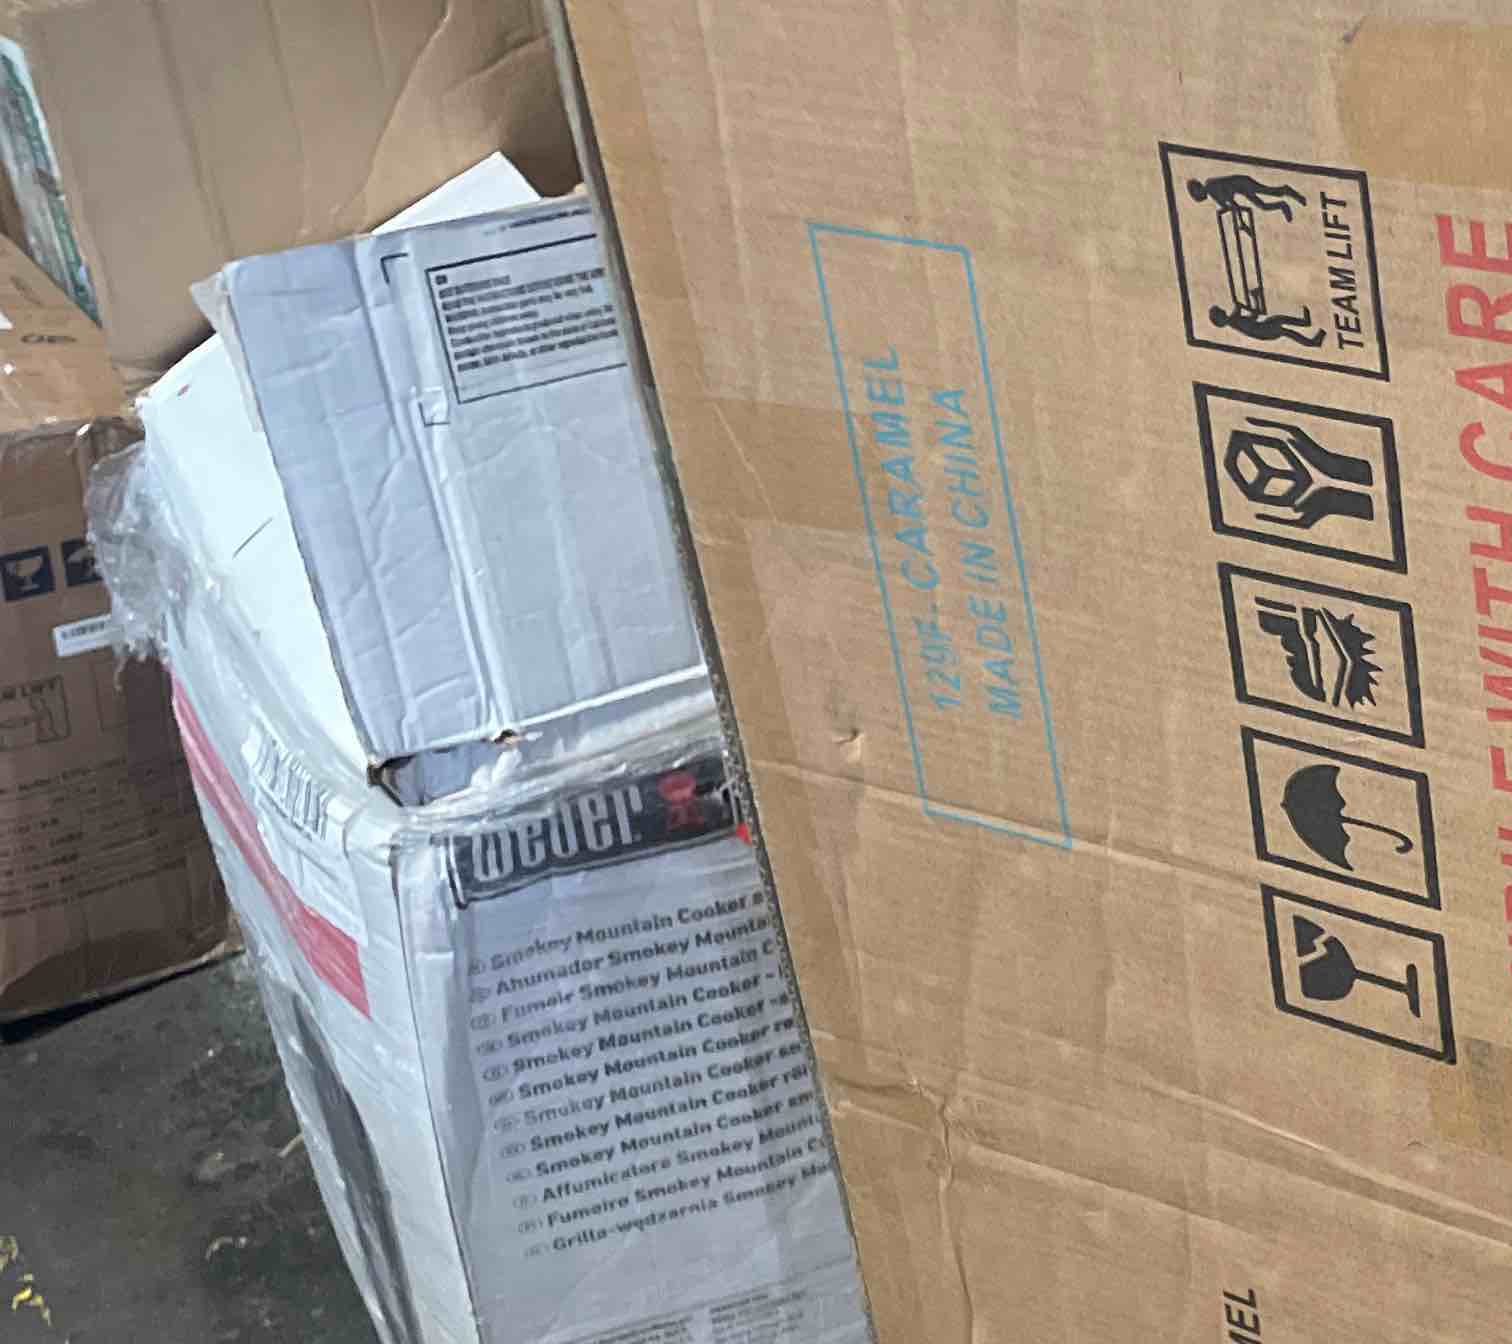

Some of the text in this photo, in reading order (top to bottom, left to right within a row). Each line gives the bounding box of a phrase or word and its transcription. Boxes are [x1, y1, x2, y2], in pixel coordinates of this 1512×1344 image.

[1318, 192, 1368, 352] TEAM LIFT
[864, 344, 941, 591] CARAMEL
[931, 385, 1022, 720] MADE IN CHINA
[576, 916, 673, 945] Mountain
[677, 897, 747, 925] Cooker
[608, 936, 689, 967] Smokey
[696, 917, 767, 948] Mounta
[593, 993, 687, 1025] Mountain
[692, 975, 761, 1004] Cooker
[599, 1018, 692, 1051] Mountain
[697, 1000, 765, 1029] Cooker
[605, 1044, 697, 1076] Mountain
[702, 1025, 770, 1054] Cooker
[707, 1050, 775, 1080] Cooker
[615, 1096, 706, 1129] Mountain
[620, 1122, 712, 1154] Mountain
